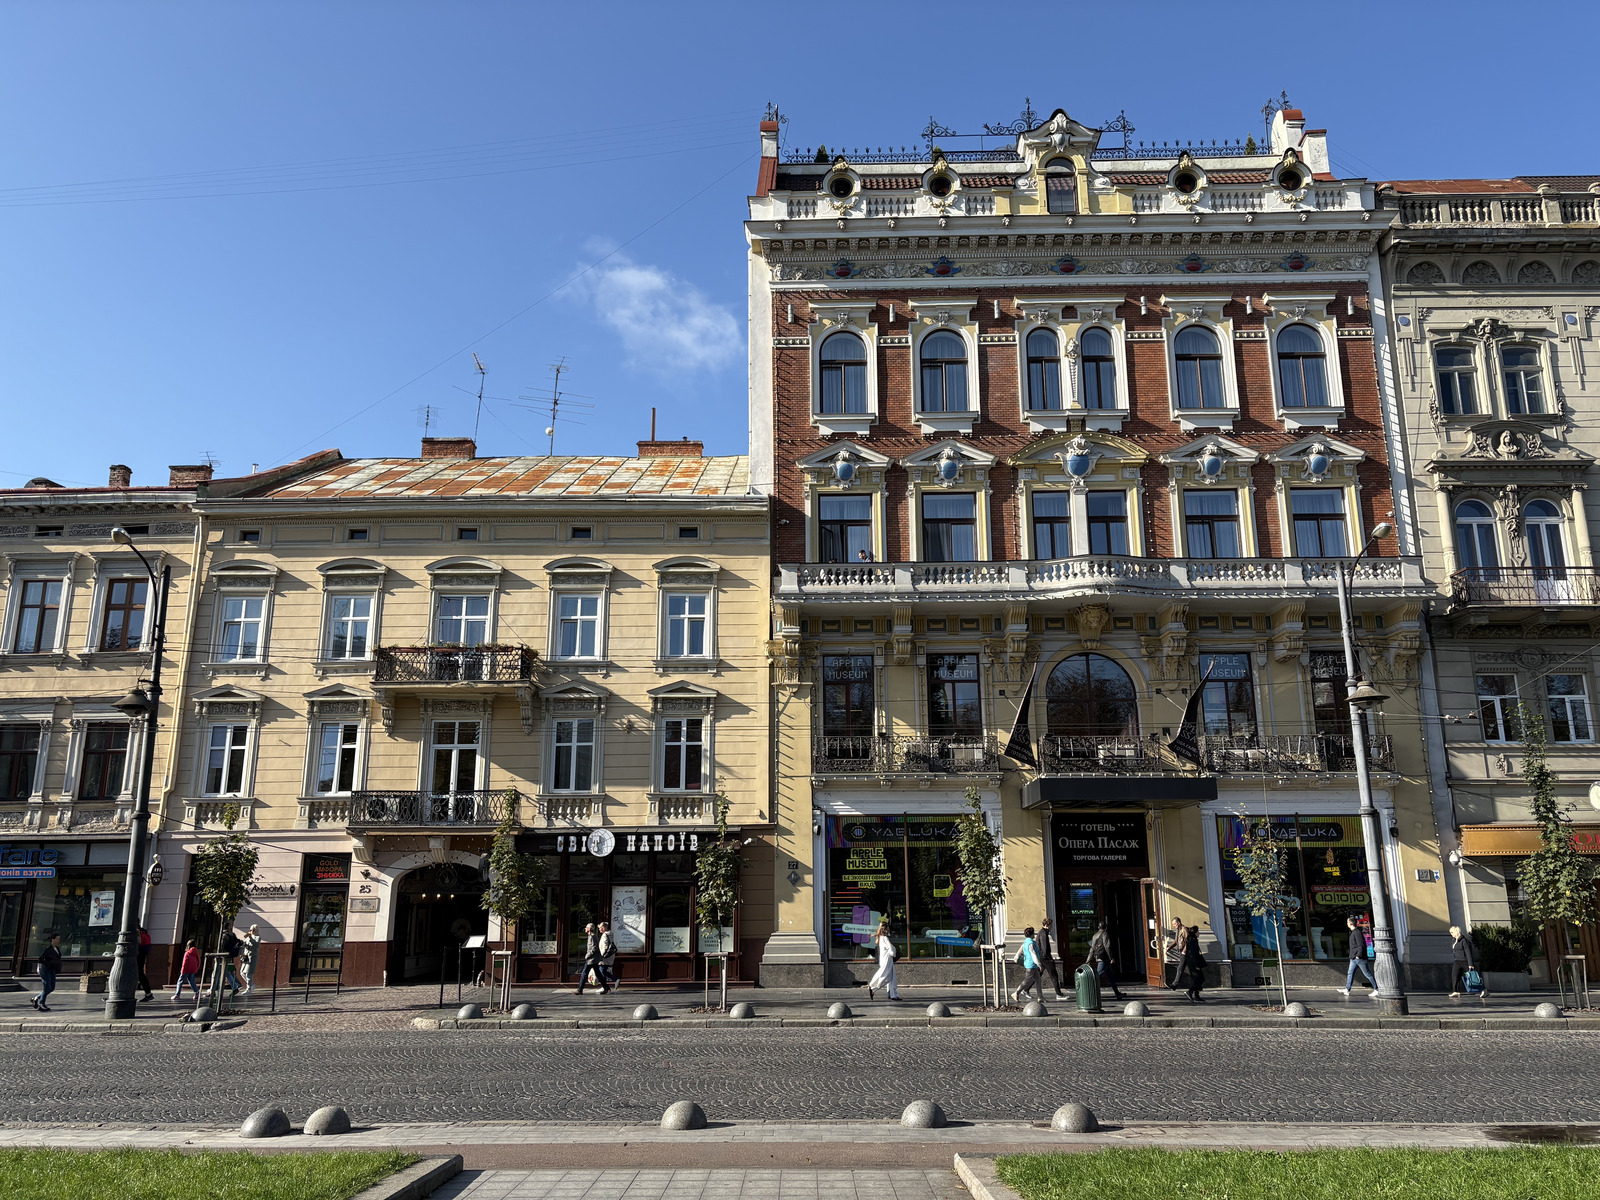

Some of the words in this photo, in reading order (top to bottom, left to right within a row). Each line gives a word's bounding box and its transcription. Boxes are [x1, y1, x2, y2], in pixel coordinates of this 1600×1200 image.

[829, 670, 868, 679] MUSEUM
[933, 669, 973, 678] MUSEUM
[1313, 666, 1347, 676] MUSEU
[1080, 823, 1116, 832] ГОТЕЛЬ
[556, 835, 600, 852] СВІТ
[626, 832, 698, 852] НАПОЇВ
[852, 849, 883, 858] APPLE
[847, 859, 886, 869] MUSEUM
[23, 870, 53, 878] взуття
[1420, 871, 1429, 879] 27
[359, 884, 371, 893] 25
